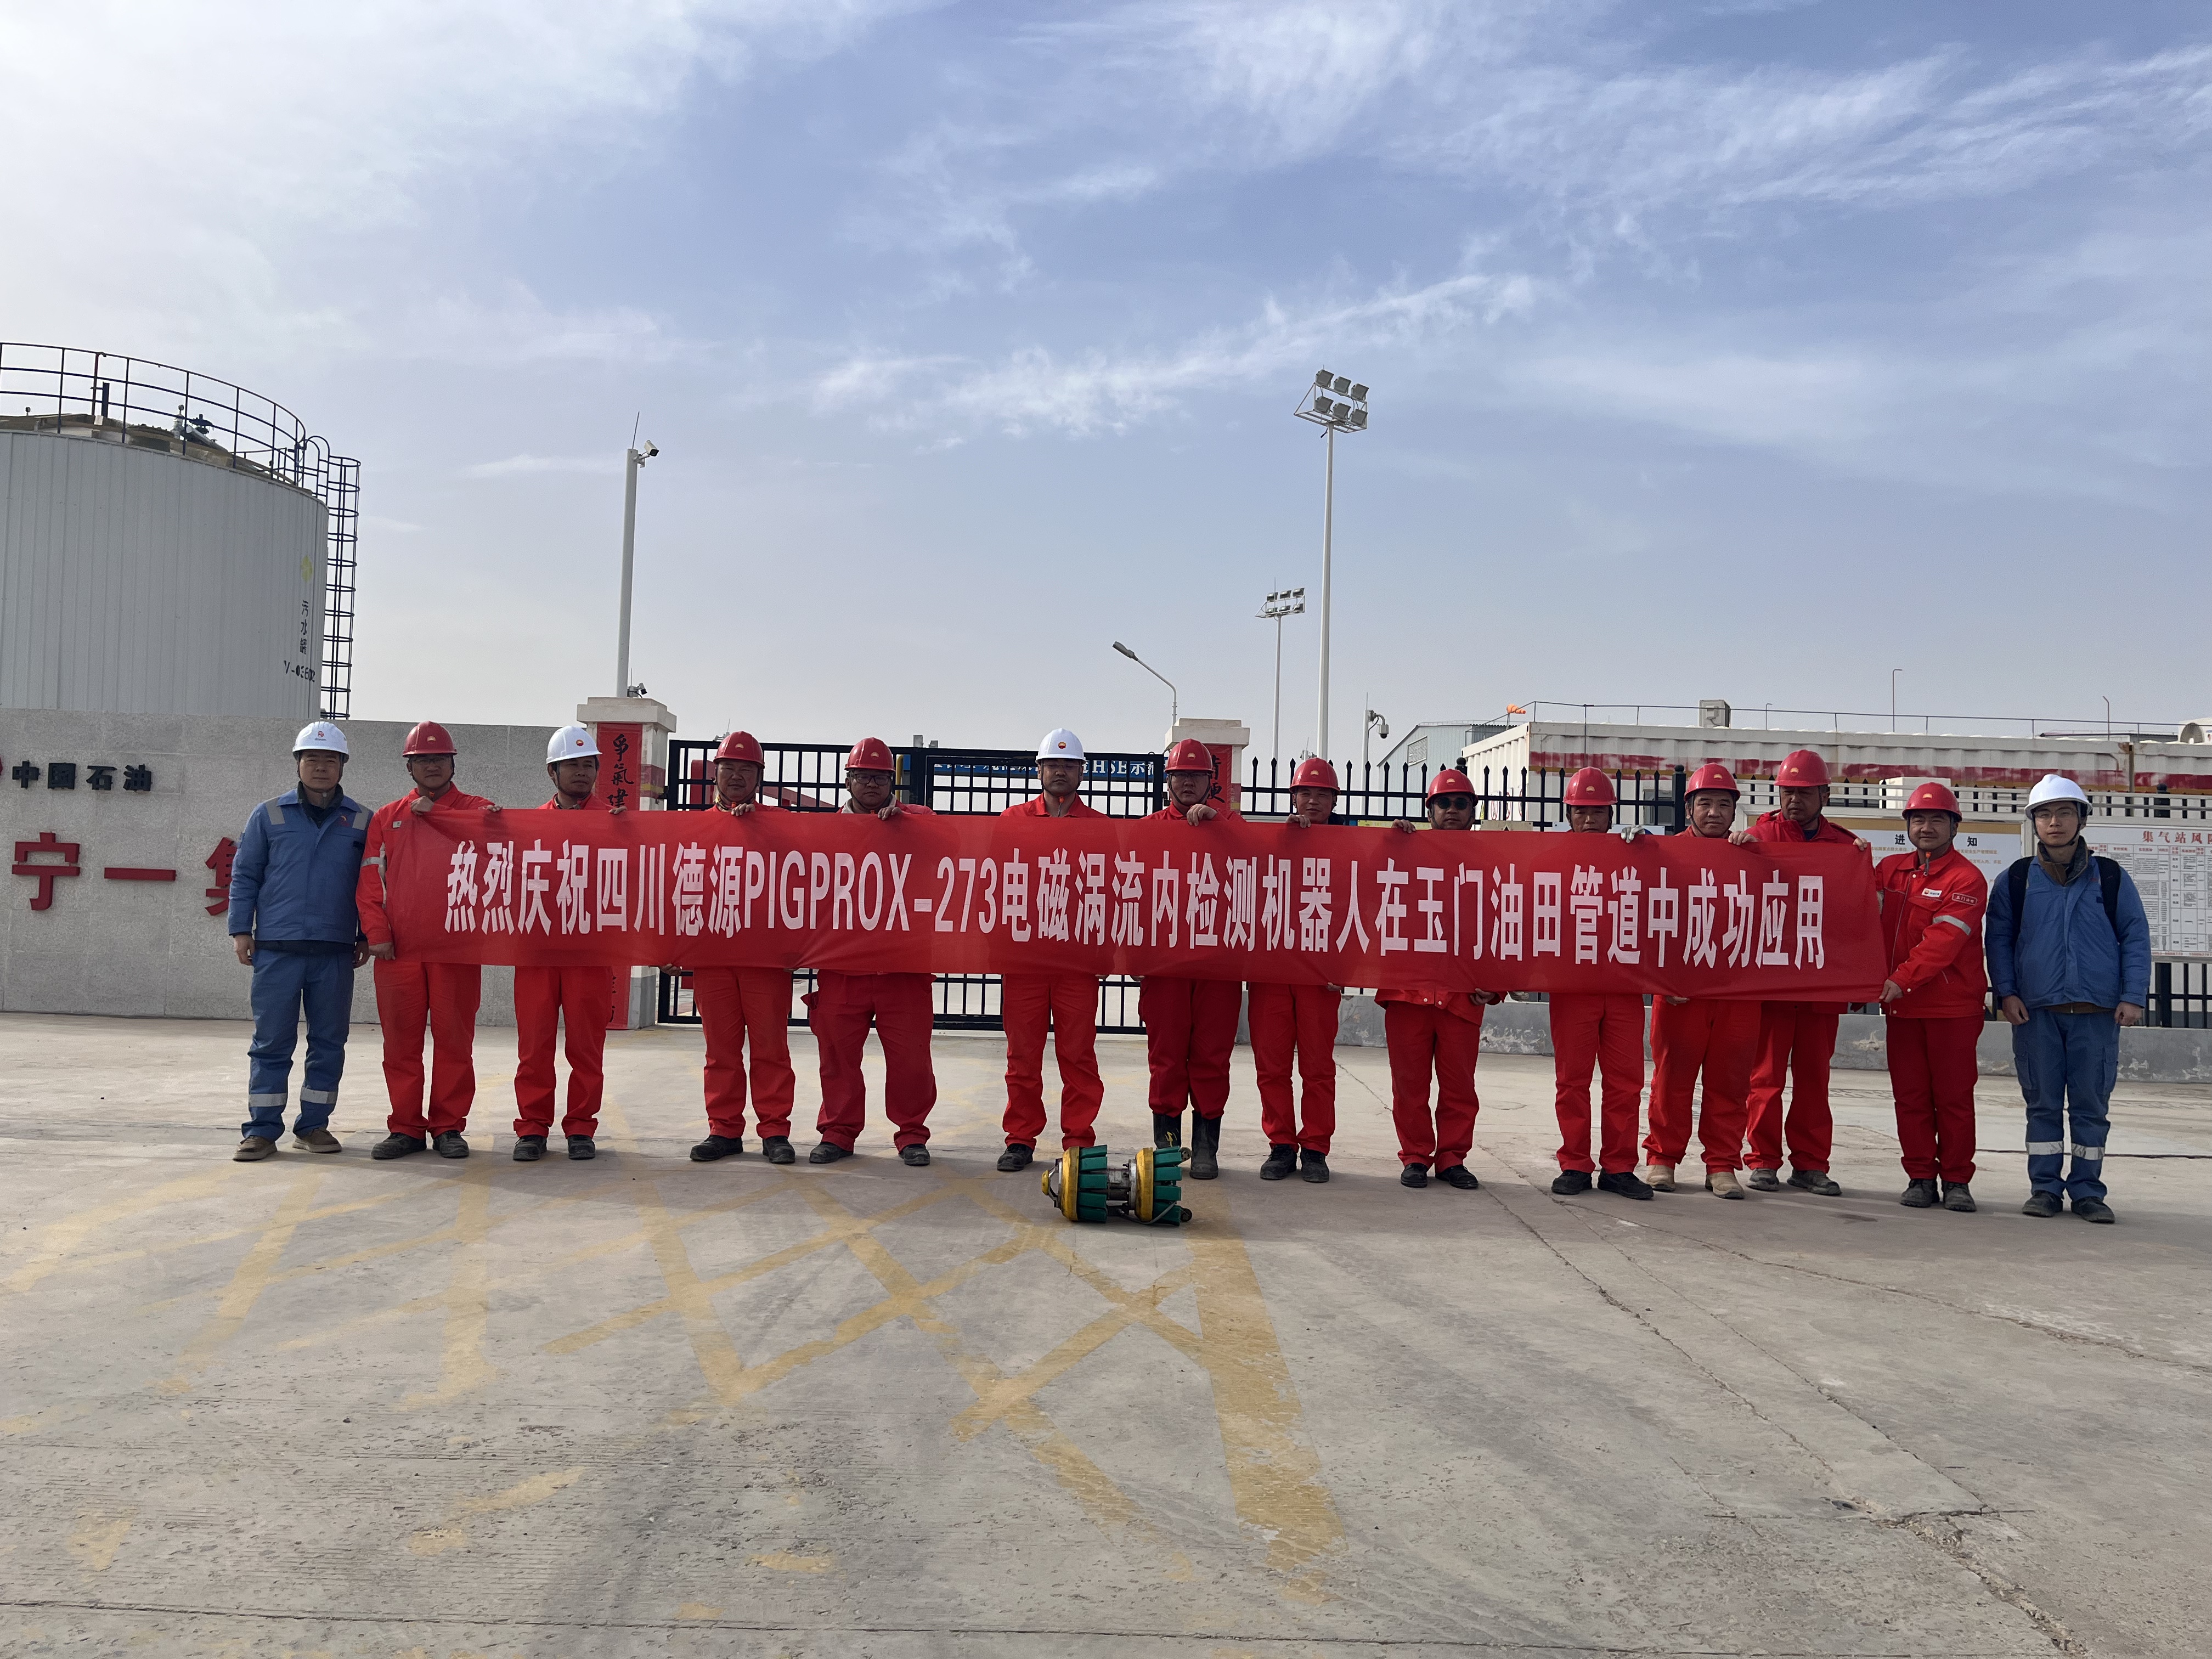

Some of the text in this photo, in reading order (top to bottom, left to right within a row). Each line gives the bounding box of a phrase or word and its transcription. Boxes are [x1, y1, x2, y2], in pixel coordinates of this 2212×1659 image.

[444, 838, 1825, 970] 热烈庆祝四川德源PIGPROX-273电磁涡流内检测机器人在玉门油田管道中成功应用
